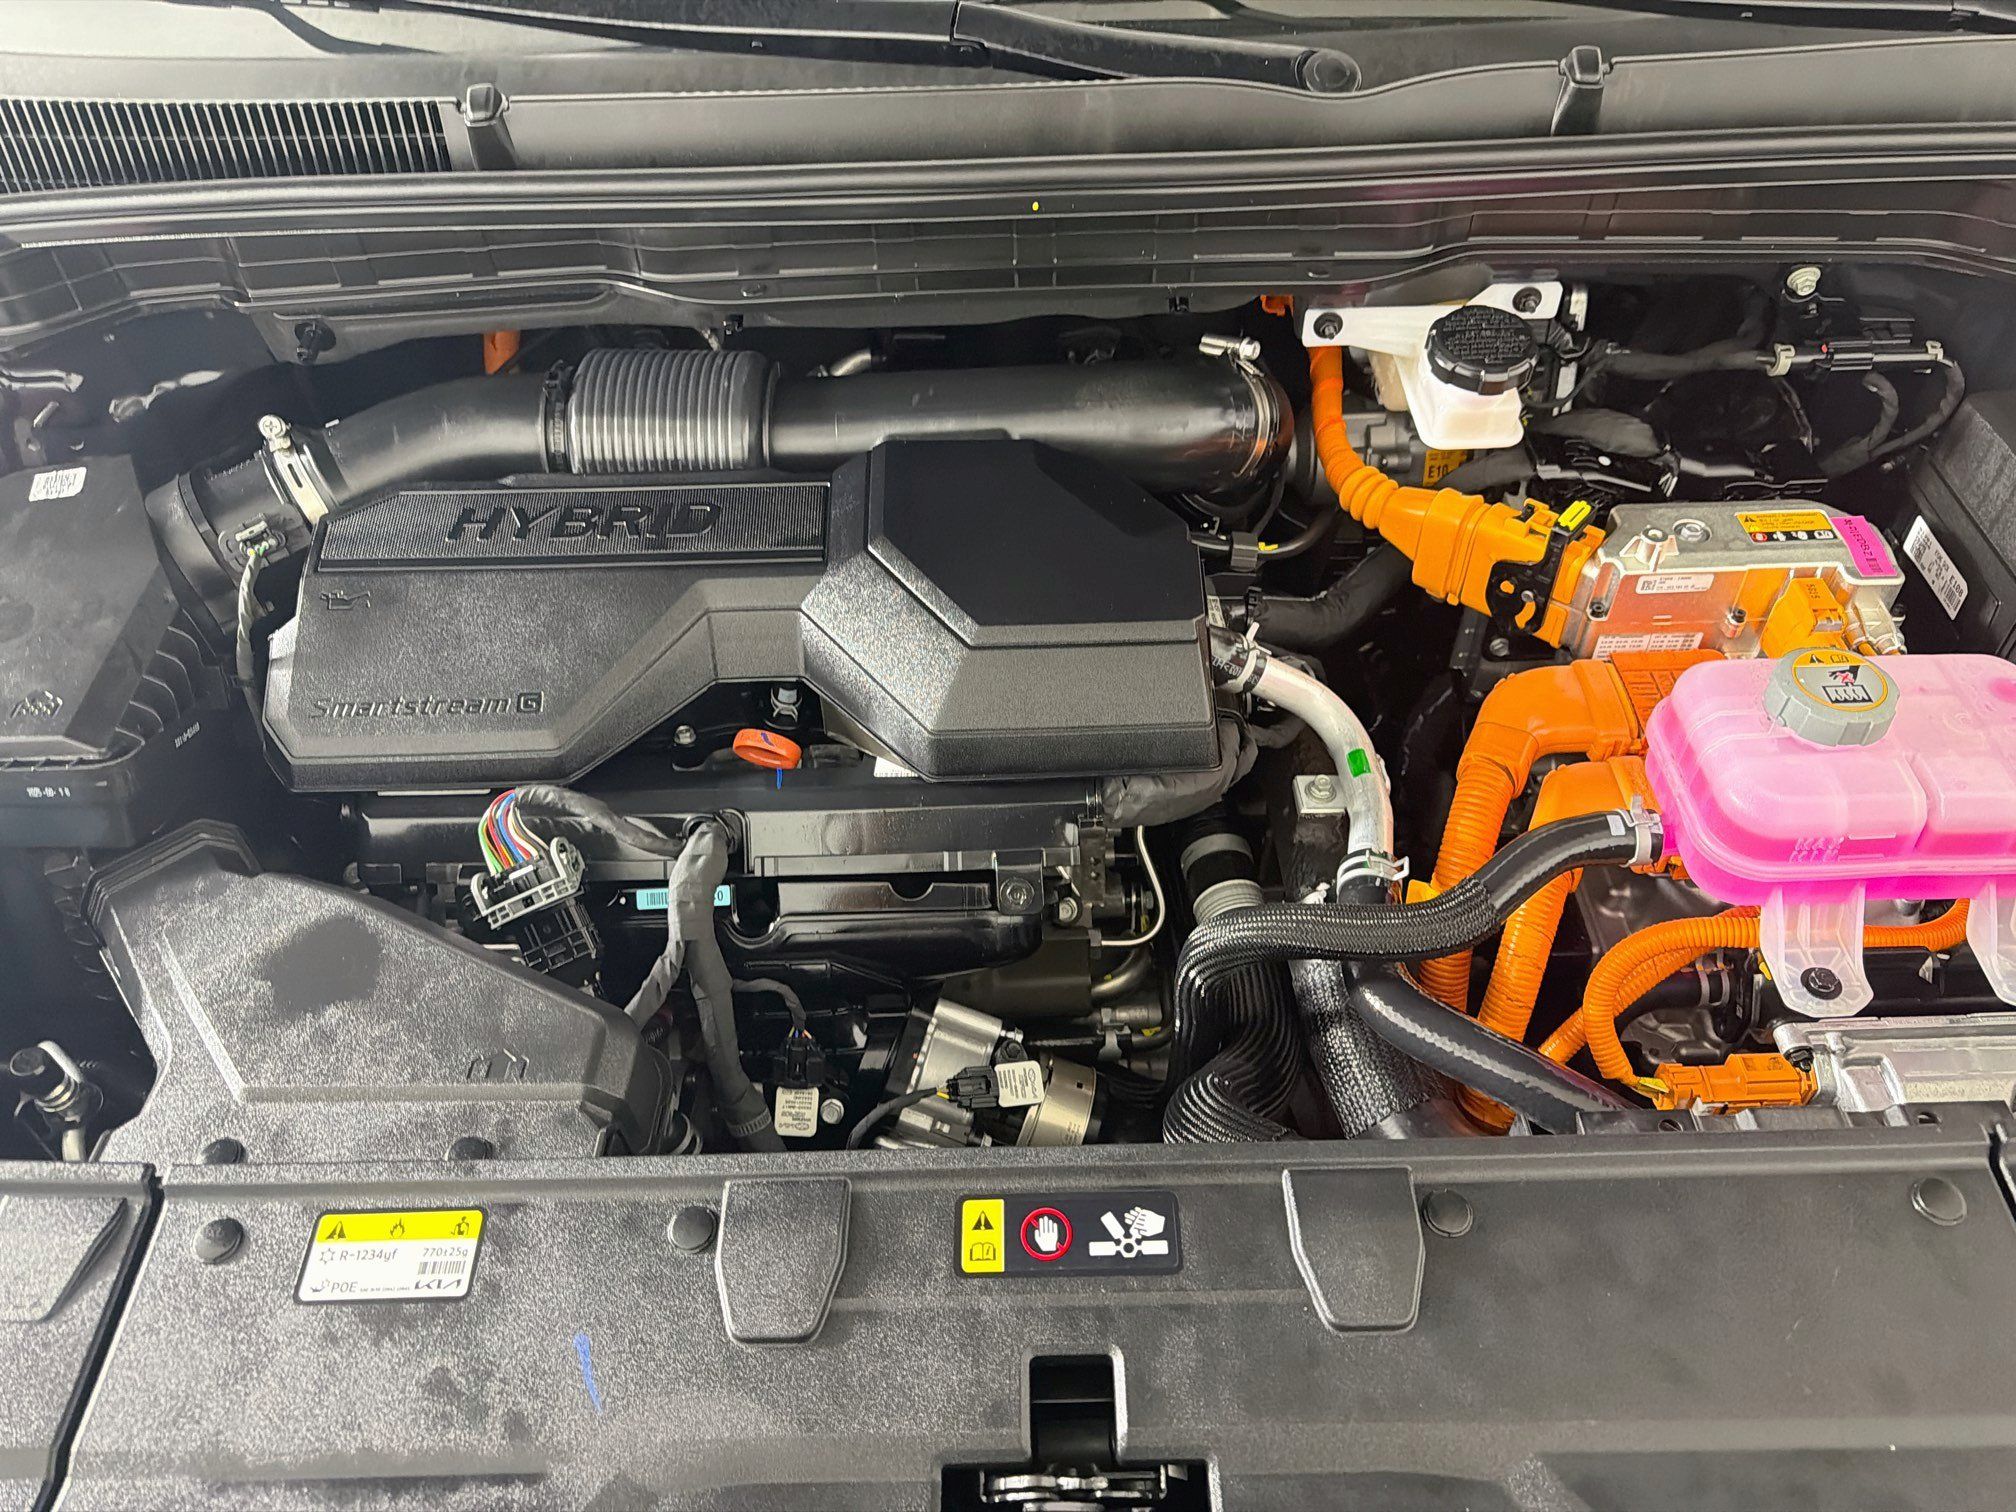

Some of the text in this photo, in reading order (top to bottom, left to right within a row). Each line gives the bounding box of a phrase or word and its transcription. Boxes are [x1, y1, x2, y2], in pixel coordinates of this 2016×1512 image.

[445, 502, 721, 542] HYBRID
[309, 696, 512, 719] Smartstream
[339, 1248, 399, 1262] R-1234yf
[331, 1281, 358, 1293] POE
[414, 1279, 462, 1290] KIA
